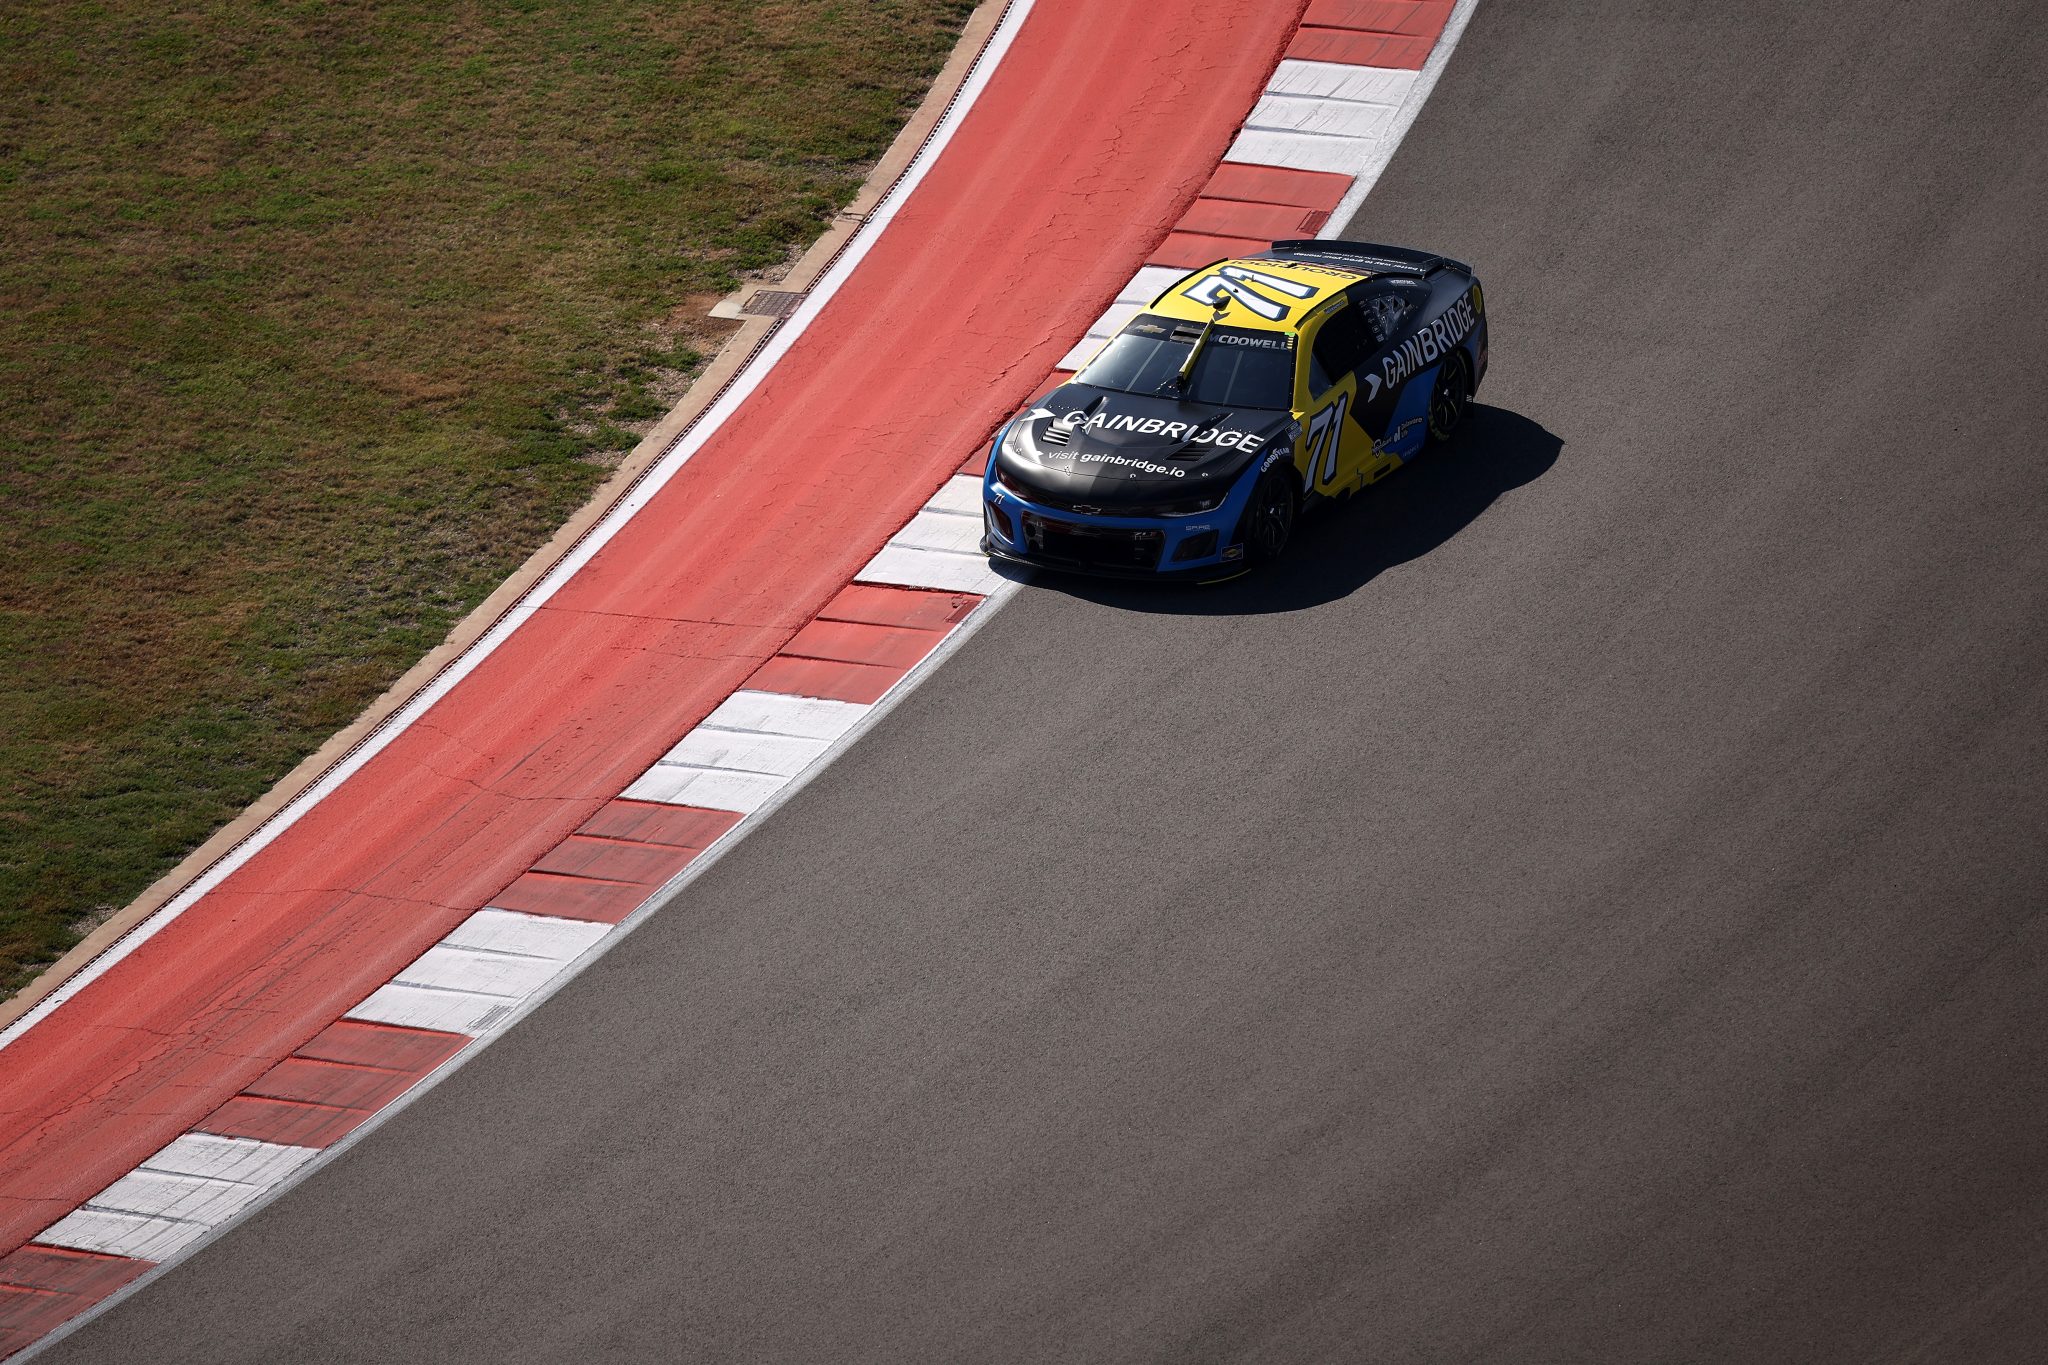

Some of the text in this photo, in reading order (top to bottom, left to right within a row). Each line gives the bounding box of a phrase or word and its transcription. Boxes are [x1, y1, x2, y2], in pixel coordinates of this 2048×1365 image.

[1181, 266, 1320, 322] 71
[1382, 292, 1475, 389] GAINBRIDGE
[1062, 410, 1264, 453] GAINBRIDGE
[1304, 391, 1348, 500] 71
[1049, 452, 1186, 478] visit gainbridge.io
[994, 493, 1005, 504] 71
